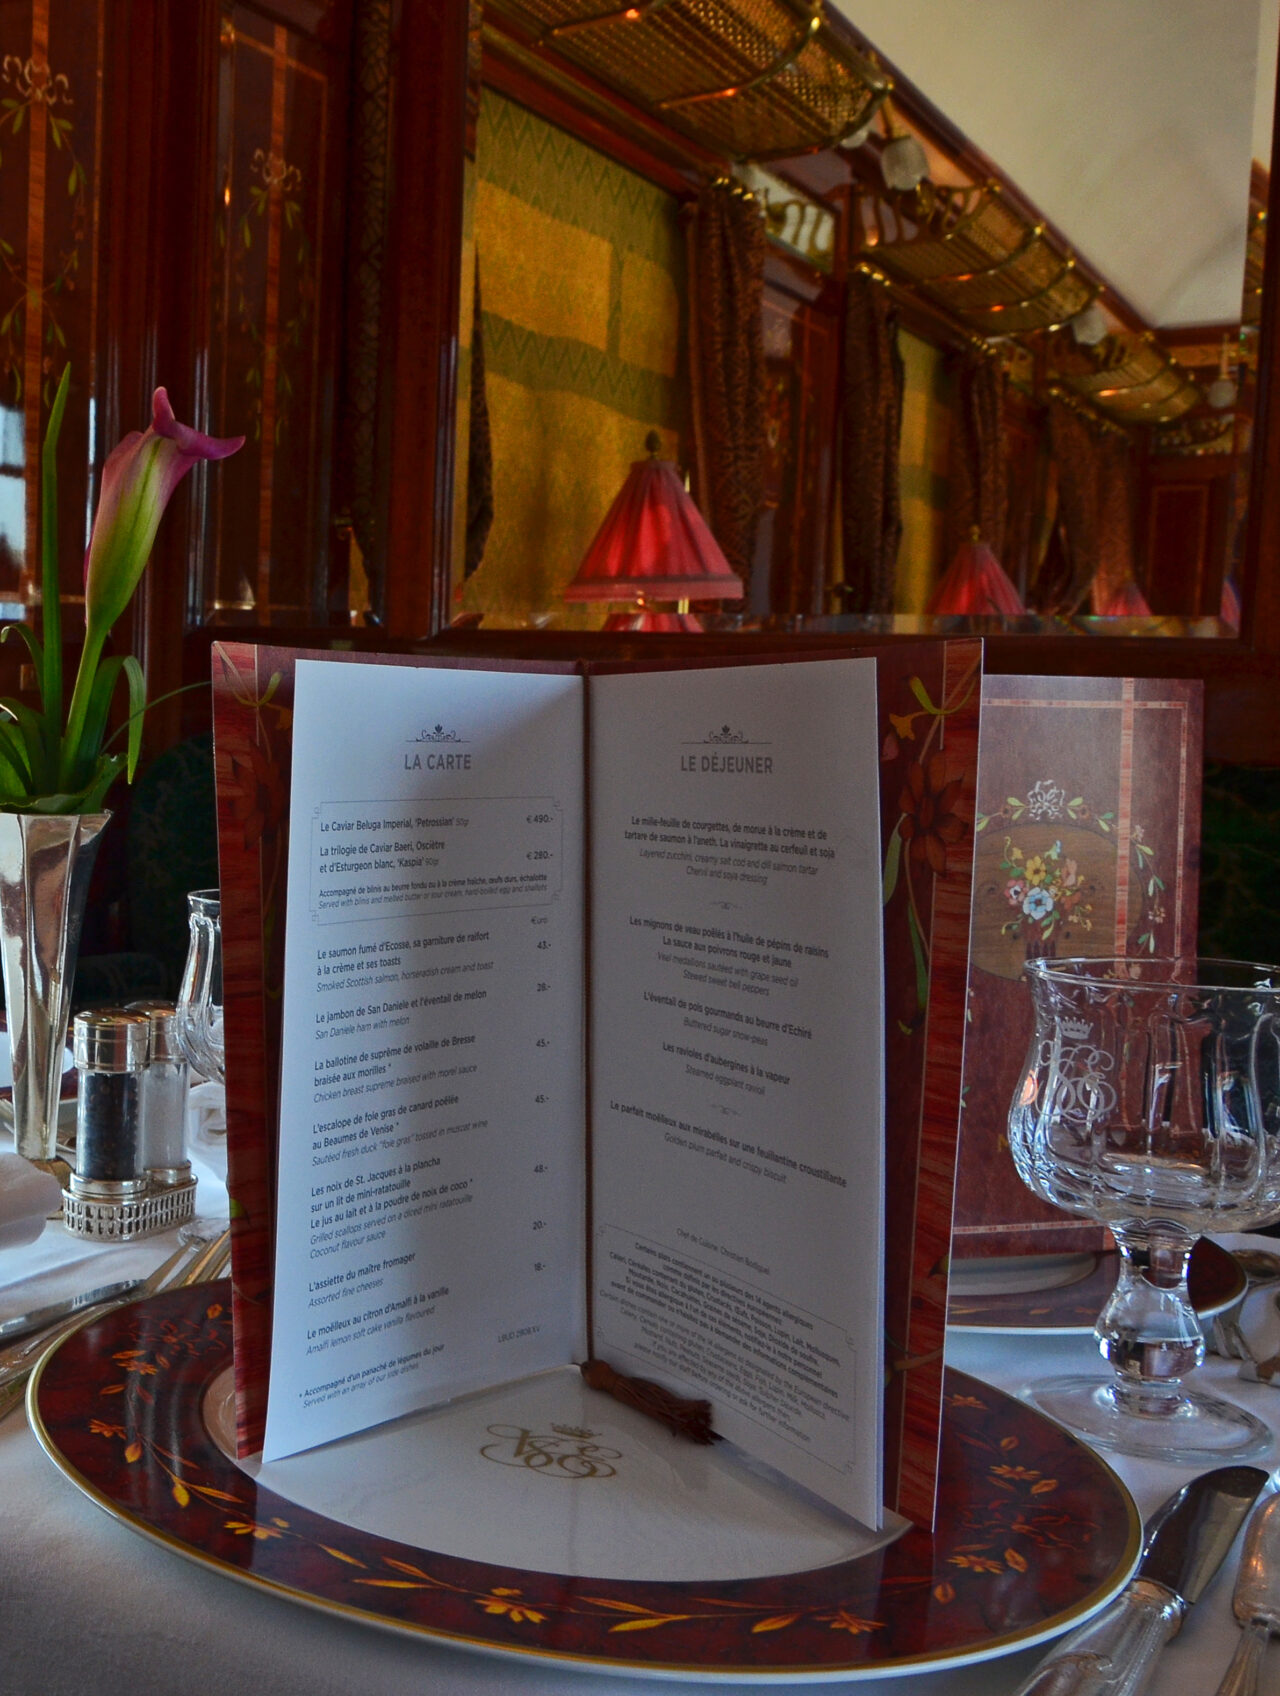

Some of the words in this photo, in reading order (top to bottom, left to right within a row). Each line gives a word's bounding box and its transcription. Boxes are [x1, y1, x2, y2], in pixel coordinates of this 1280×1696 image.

[404, 754, 422, 770] LA
[426, 753, 471, 770] CARTE
[680, 755, 696, 772] LE
[701, 753, 772, 773] DÉJEUNER
[320, 822, 329, 832] Le
[331, 820, 354, 831] Caviar
[356, 819, 381, 831] Beluga
[382, 817, 413, 830] Imperial,
[526, 814, 532, 823] €
[533, 814, 553, 823] 490.-
[319, 847, 328, 856] La
[330, 844, 357, 856] trilogie
[358, 843, 368, 853] de
[369, 842, 392, 853] Caviar
[393, 841, 414, 852] Baeri,
[525, 851, 532, 860] €
[533, 850, 553, 860] 280.-
[319, 863, 327, 873] et
[328, 861, 372, 872] d'Esturgeon
[374, 858, 395, 869] blanc,
[317, 950, 326, 959] Le
[328, 947, 356, 958] saumon
[358, 942, 377, 954] fumé
[378, 940, 411, 951] d'Ecosse,
[412, 939, 421, 948] sa
[422, 935, 454, 949] garniture
[456, 933, 465, 943] de
[467, 931, 489, 941] raifort
[536, 940, 551, 949] 43.-
[629, 915, 642, 926] Les
[643, 918, 672, 931] mignons
[673, 923, 683, 932] de
[726, 930, 731, 940] à
[732, 931, 754, 944] l'huile
[755, 935, 765, 946] de
[766, 938, 791, 951] pépins
[792, 942, 803, 954] de
[804, 946, 829, 958] raisins
[662, 935, 672, 945] La
[672, 938, 692, 949] sauce
[693, 942, 706, 951] aux
[707, 944, 737, 958] poivrons
[739, 950, 760, 963] rouge
[761, 954, 770, 964] et
[771, 954, 792, 968] jaune
[316, 965, 321, 976] à
[323, 964, 330, 974] la
[331, 962, 354, 974] crème
[356, 960, 364, 970] et
[365, 960, 377, 969] ses
[379, 956, 401, 967] toasts
[315, 1013, 325, 1023] Le
[326, 1009, 354, 1023] jambon
[355, 1006, 365, 1016] de
[367, 1004, 380, 1014] San
[382, 999, 409, 1012] Daniele
[410, 998, 418, 1008] et
[419, 993, 451, 1006] l'éventail
[452, 992, 462, 1002] de
[464, 989, 486, 1000] melon
[677, 999, 687, 1008] de
[688, 1002, 703, 1013] pois
[703, 1005, 743, 1022] gourmands
[744, 1015, 754, 1025] au
[755, 1016, 780, 1031] beurre
[314, 1061, 323, 1070] La
[325, 1054, 357, 1068] ballotine
[359, 1051, 369, 1062] de
[370, 1047, 401, 1060] suprême
[403, 1043, 412, 1054] de
[414, 1040, 439, 1052] volaille
[440, 1038, 450, 1047] de
[451, 1035, 475, 1046] Bresse
[535, 1038, 550, 1047] 45.-
[314, 1073, 340, 1087] braisée
[342, 1071, 355, 1081] aux
[357, 1065, 386, 1078] morilles
[534, 1094, 549, 1103] 45.-
[313, 1118, 351, 1134] L'escalope
[353, 1114, 362, 1125] de
[364, 1111, 378, 1122] foie
[379, 1108, 395, 1120] gras
[397, 1104, 407, 1115] de
[408, 1099, 432, 1112] canard
[312, 1141, 321, 1150] au
[323, 1132, 357, 1147] Beaumes
[358, 1128, 368, 1139] de
[370, 1123, 394, 1136] Venise
[311, 1186, 324, 1197] Les
[326, 1181, 342, 1193] noix
[343, 1178, 353, 1188] de
[355, 1175, 365, 1185] St.
[366, 1168, 396, 1182] Jacques
[397, 1165, 402, 1174] à
[404, 1163, 411, 1172] la
[412, 1157, 440, 1173] plancha
[533, 1164, 548, 1173] 48.-
[310, 1202, 322, 1213] sur
[324, 1199, 334, 1209] un
[345, 1193, 355, 1203] de
[356, 1179, 410, 1200] mini-ratatouille
[310, 1219, 320, 1229] Le
[321, 1215, 333, 1228] jus
[334, 1213, 344, 1222] au
[345, 1207, 357, 1218] lait
[358, 1205, 367, 1215] et
[368, 1203, 373, 1212] à
[375, 1201, 381, 1210] la
[383, 1194, 409, 1210] poudre
[410, 1191, 420, 1201] de
[421, 1187, 437, 1198] noix
[438, 1184, 448, 1194] de
[449, 1180, 468, 1191] coco
[532, 1220, 546, 1230] 20.-
[308, 1274, 344, 1292] L'assiette
[345, 1270, 356, 1280] du
[357, 1263, 380, 1277] maître
[382, 1252, 415, 1269] fromager
[307, 1330, 316, 1339] Le
[352, 1315, 361, 1324] au
[362, 1307, 383, 1321] citron
[384, 1296, 411, 1314] d'Amalfi
[413, 1295, 417, 1304] à
[419, 1293, 425, 1302] la
[427, 1286, 449, 1300] vanille
